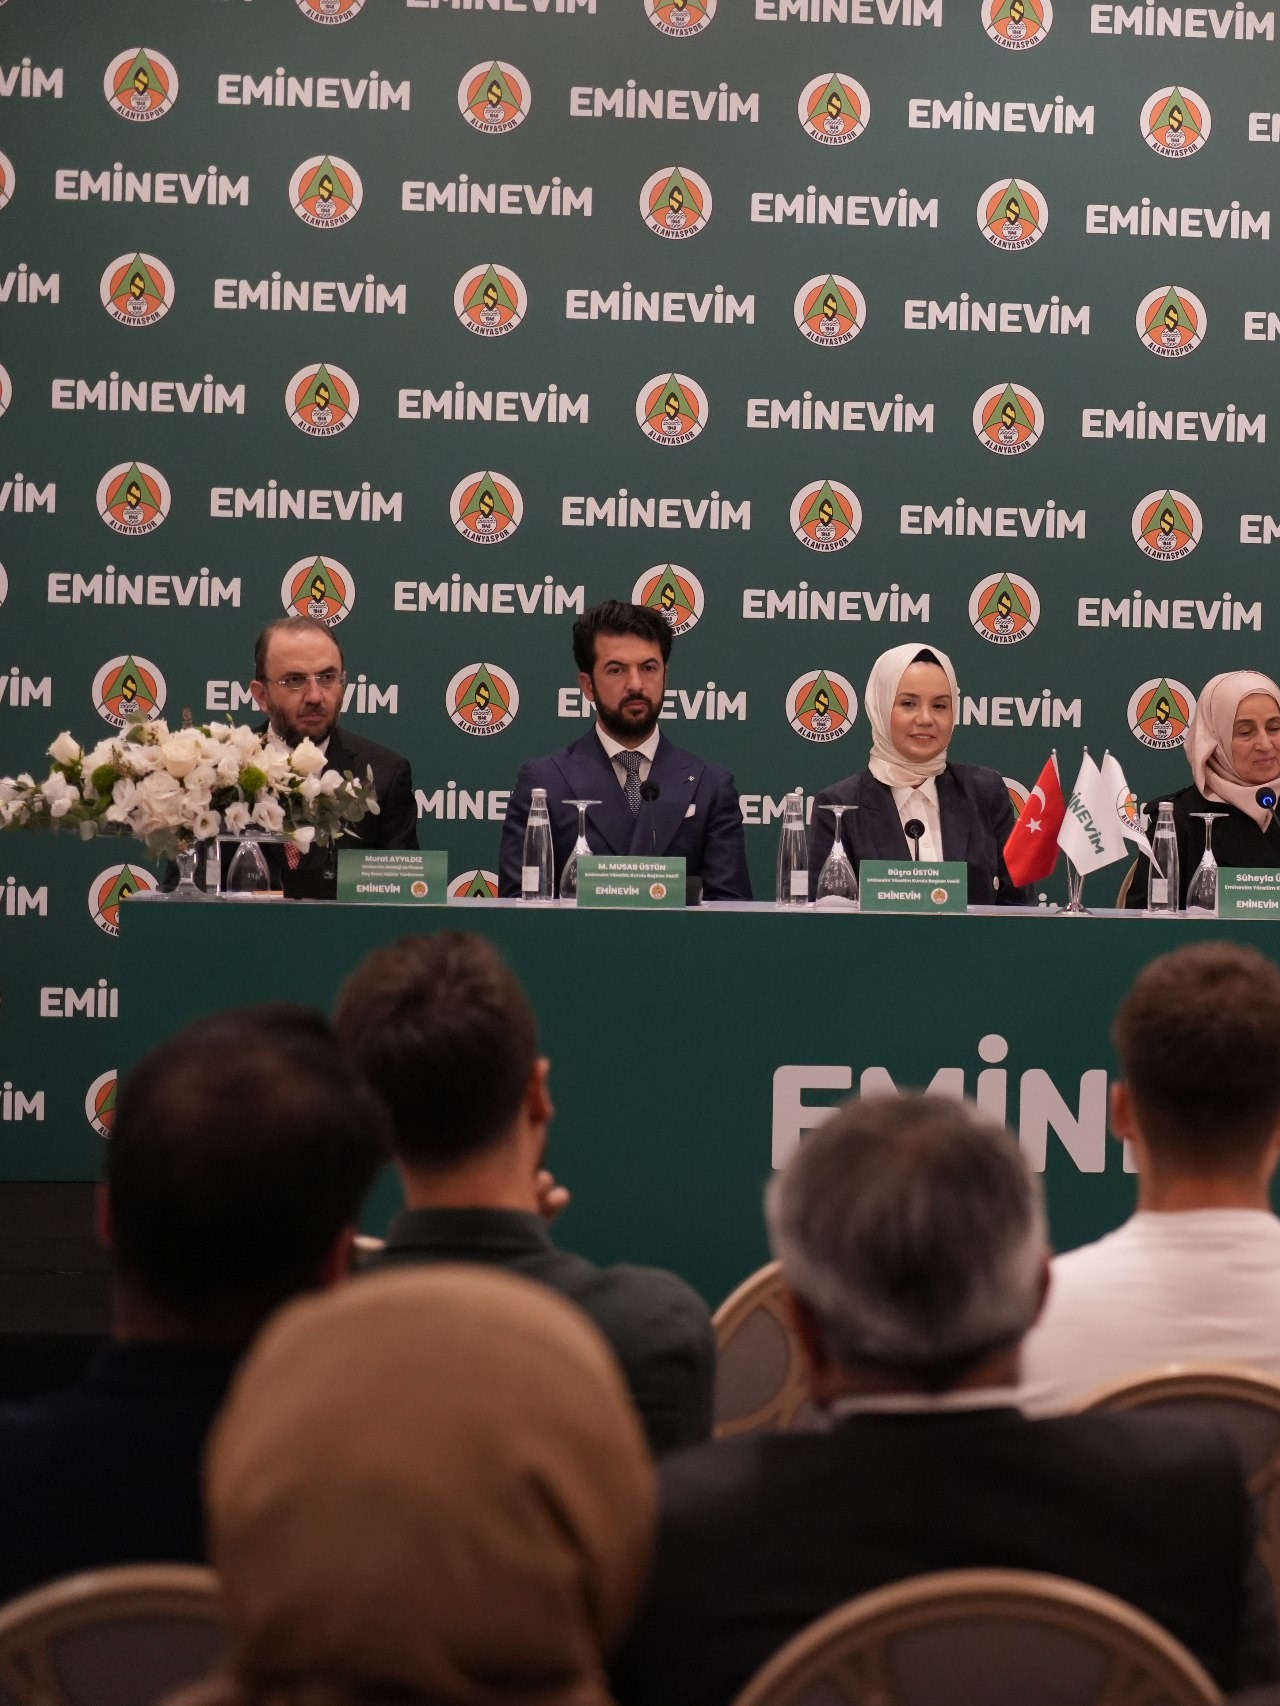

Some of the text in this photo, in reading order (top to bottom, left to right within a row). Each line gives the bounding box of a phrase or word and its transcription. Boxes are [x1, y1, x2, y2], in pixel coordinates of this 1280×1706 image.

[218, 67, 410, 110] EMİNEVİM
[570, 79, 759, 122] EMİNEVİM
[909, 92, 1094, 134] EMİNEVİM
[1152, 143, 1198, 157] ALANYASPOR
[55, 162, 249, 206] EMİNEVİM
[402, 174, 592, 216] EMİNEVİM
[751, 185, 938, 228] EMİNEVİM
[1086, 197, 1270, 240] EMİNEVİM
[989, 235, 1035, 249] ALANYASPOR
[214, 271, 406, 314] EMİNEVİM
[566, 282, 754, 324] EMİNEVİM
[905, 293, 1090, 335] EMİNEVİM
[806, 331, 853, 345] ALANYASPOR
[1148, 342, 1194, 356] ALANYASPOR
[52, 371, 245, 414] EMİNEVİM
[398, 381, 588, 423] EMİNEVİM
[747, 391, 934, 433] EMİNEVİM
[648, 430, 695, 444] ALANYASPOR
[1082, 401, 1265, 443] EMİNEVİM
[985, 440, 1031, 454] ALANYASPOR
[210, 480, 402, 522] EMİNEVİM
[562, 489, 750, 530] EMİNEVİM
[900, 497, 1085, 539] EMİNEVİM
[462, 529, 509, 543] ALANYASPOR
[802, 537, 849, 551] ALANYASPOR
[1143, 546, 1189, 560] ALANYASPOR
[48, 565, 241, 607] EMİNEVİM
[394, 573, 584, 614] EMİNEVİM
[743, 581, 930, 622] EMİNEVİM
[1078, 590, 1261, 631] EMİNEVİM
[981, 629, 1027, 643] ALANYASPOR
[458, 721, 505, 735] ALANYASPOR
[798, 727, 845, 741] ALANYASPOR
[1139, 735, 1186, 748] ALANYASPOR
[1069, 792, 1104, 855] İNEVİM
[357, 883, 400, 893] EMİNEVİM
[596, 885, 639, 895] EMİNEVİM
[888, 868, 939, 877] Büşra ÜSTÜN
[1237, 874, 1273, 883] Süheyla
[878, 891, 920, 900] EMİNEVİM
[1237, 899, 1278, 908] EMİNEVİM
